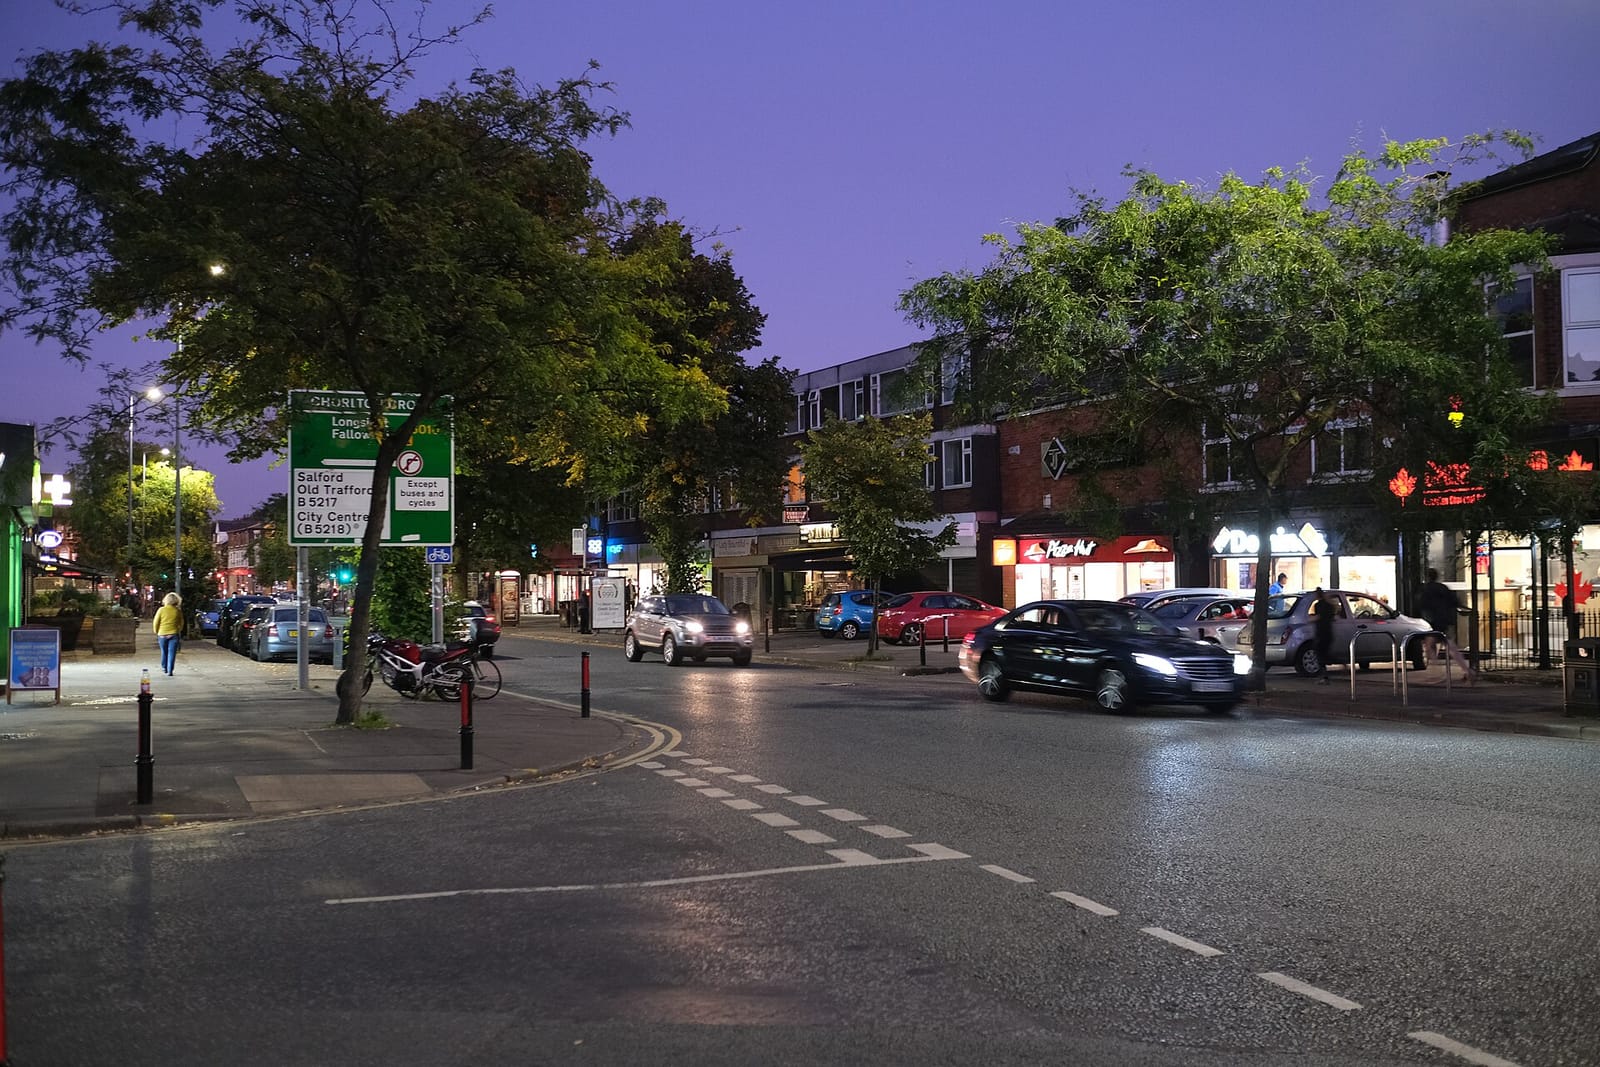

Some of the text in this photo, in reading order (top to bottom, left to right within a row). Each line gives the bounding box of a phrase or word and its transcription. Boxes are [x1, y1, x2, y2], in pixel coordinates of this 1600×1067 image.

[310, 396, 383, 409] CHORLTO
[297, 472, 343, 483] Salford
[297, 484, 319, 495] Old
[407, 480, 437, 490] Except
[400, 490, 426, 498] buses
[408, 499, 436, 508] cycles
[297, 511, 370, 523] City Centre
[1045, 539, 1097, 559] Pizza Hut
